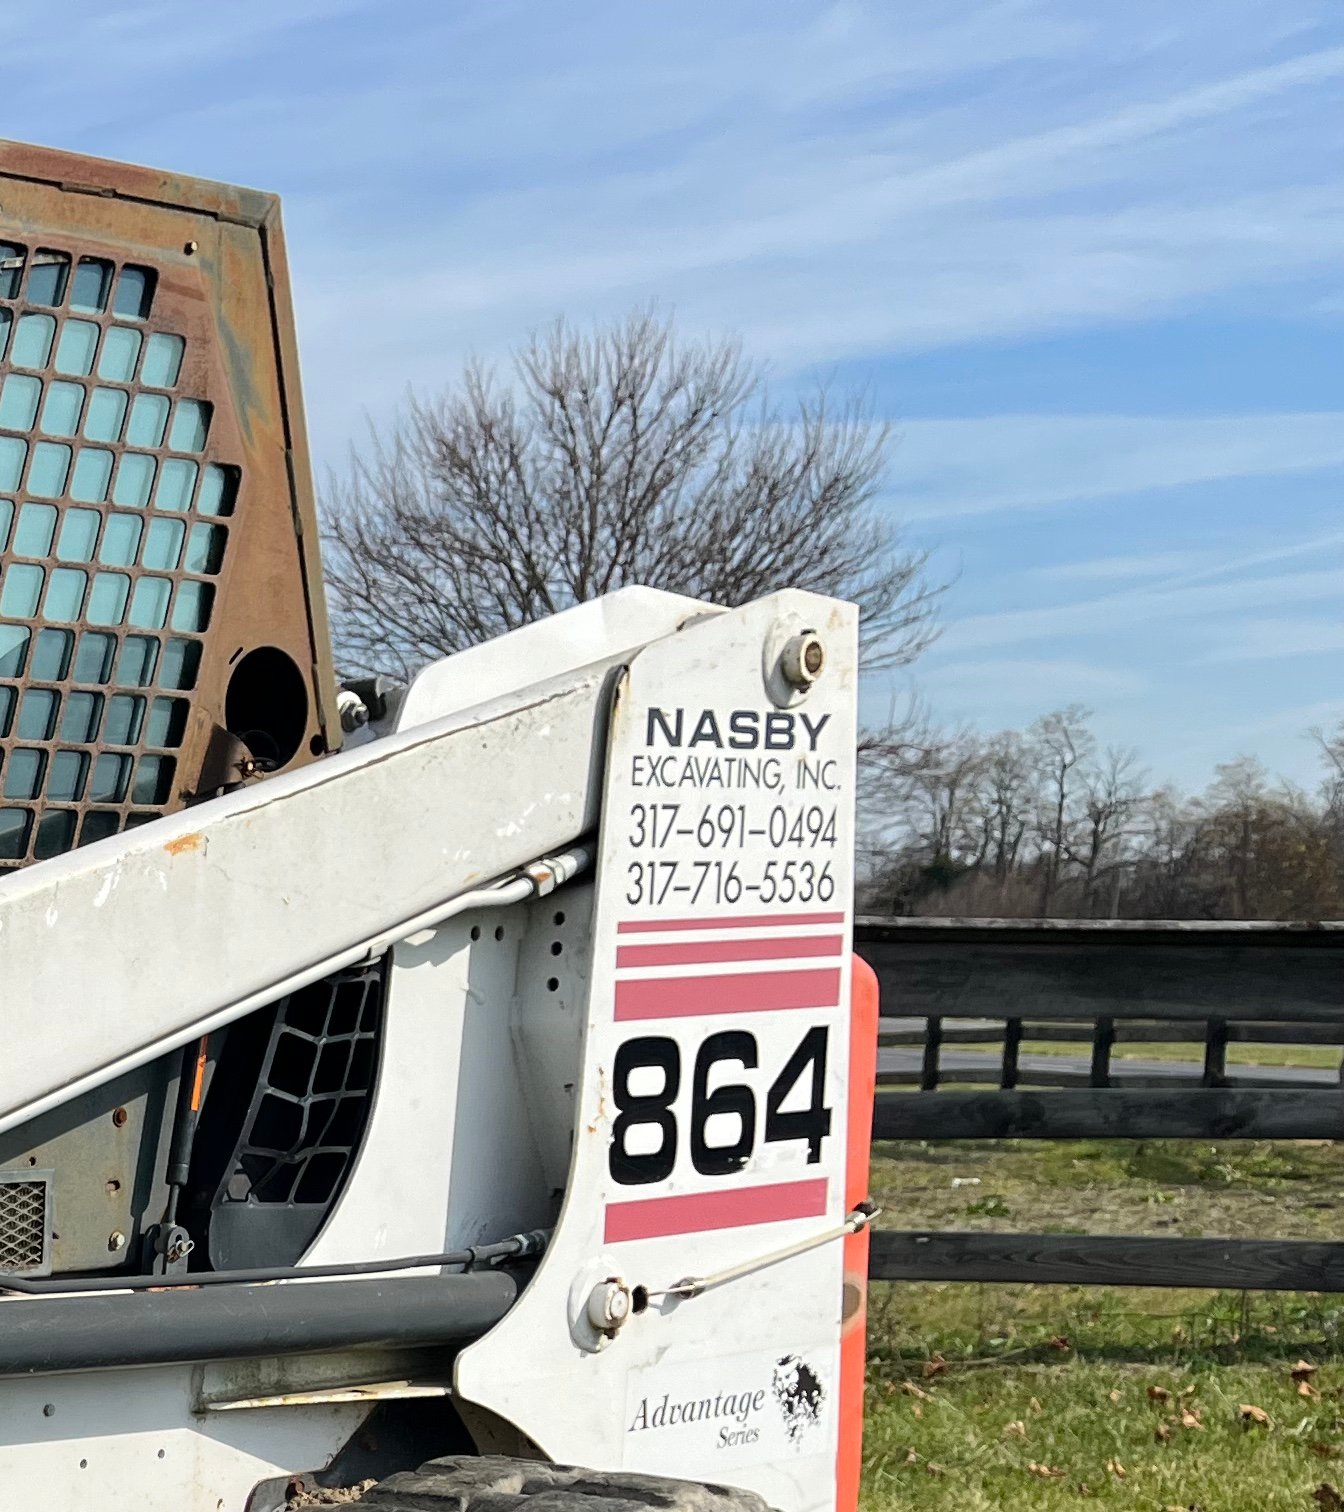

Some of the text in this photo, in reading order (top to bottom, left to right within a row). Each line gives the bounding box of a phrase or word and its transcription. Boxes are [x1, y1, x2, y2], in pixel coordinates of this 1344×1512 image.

[645, 707, 831, 751] NASBY
[631, 755, 841, 795] EXCAVATING, INC.
[628, 803, 838, 848] 317-691-0494
[626, 860, 835, 906] 317-716-5536
[608, 1025, 832, 1186] 864
[627, 1389, 765, 1432] Advantage
[716, 1423, 760, 1449] Series
